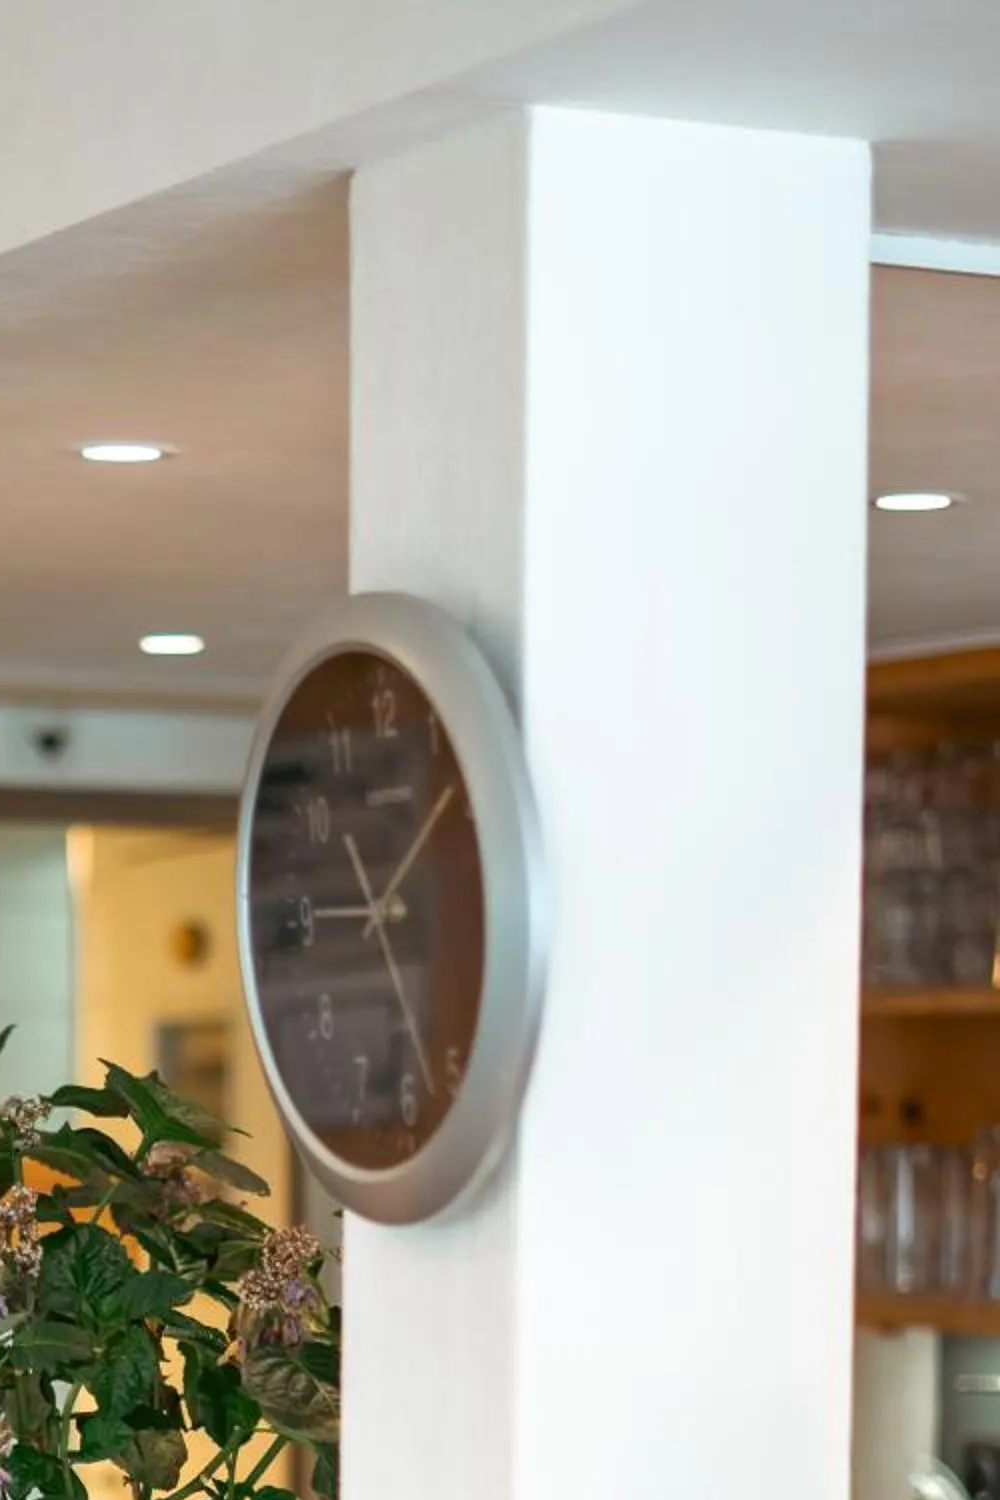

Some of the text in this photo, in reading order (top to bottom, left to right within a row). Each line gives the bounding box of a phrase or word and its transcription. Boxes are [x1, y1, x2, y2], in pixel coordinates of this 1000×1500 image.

[371, 688, 399, 738] 12
[328, 726, 352, 776] 11
[306, 795, 331, 843] 10
[300, 896, 315, 947] 9
[318, 993, 333, 1041] 8
[352, 1056, 367, 1101] 7
[401, 1073, 416, 1127] 6
